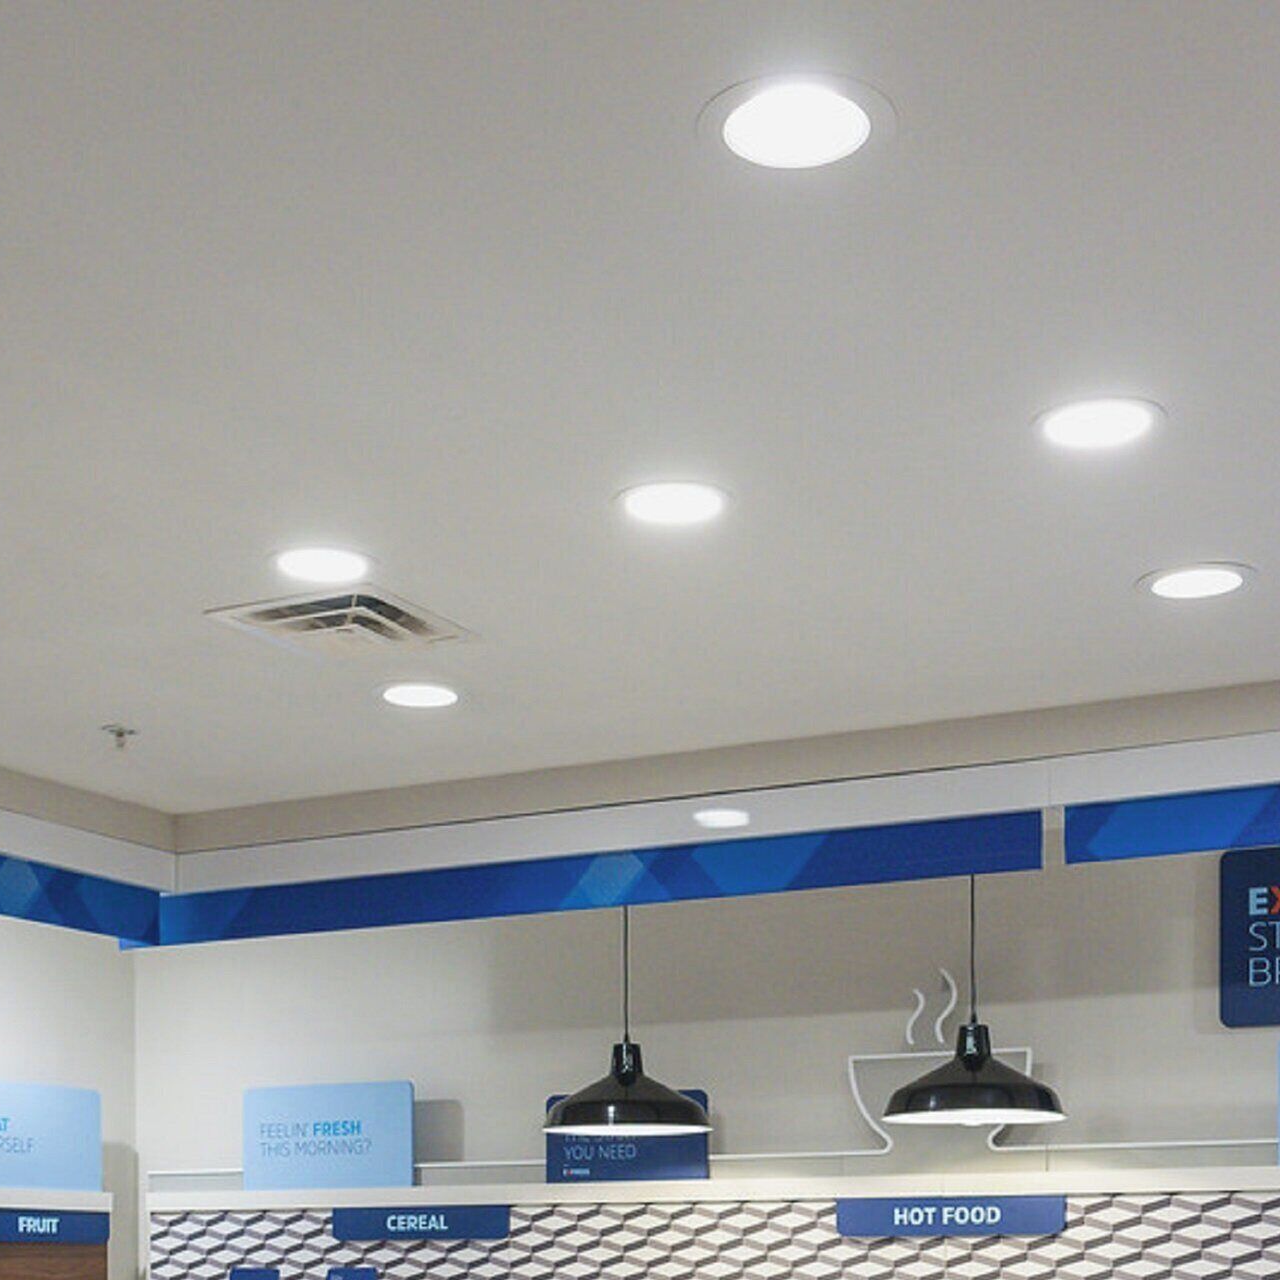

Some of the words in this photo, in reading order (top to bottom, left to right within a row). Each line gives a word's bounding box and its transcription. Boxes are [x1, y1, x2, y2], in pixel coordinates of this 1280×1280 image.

[313, 1120, 361, 1136] FRESH
[261, 1141, 291, 1158] THIS
[295, 1139, 373, 1156] MORNING?
[563, 1144, 595, 1160] YOU
[598, 1143, 637, 1160] NEED
[18, 1216, 60, 1233] FRUIT
[386, 1214, 449, 1231] CEREAL
[893, 1206, 936, 1226] HOT
[941, 1206, 1001, 1226] FOOD
